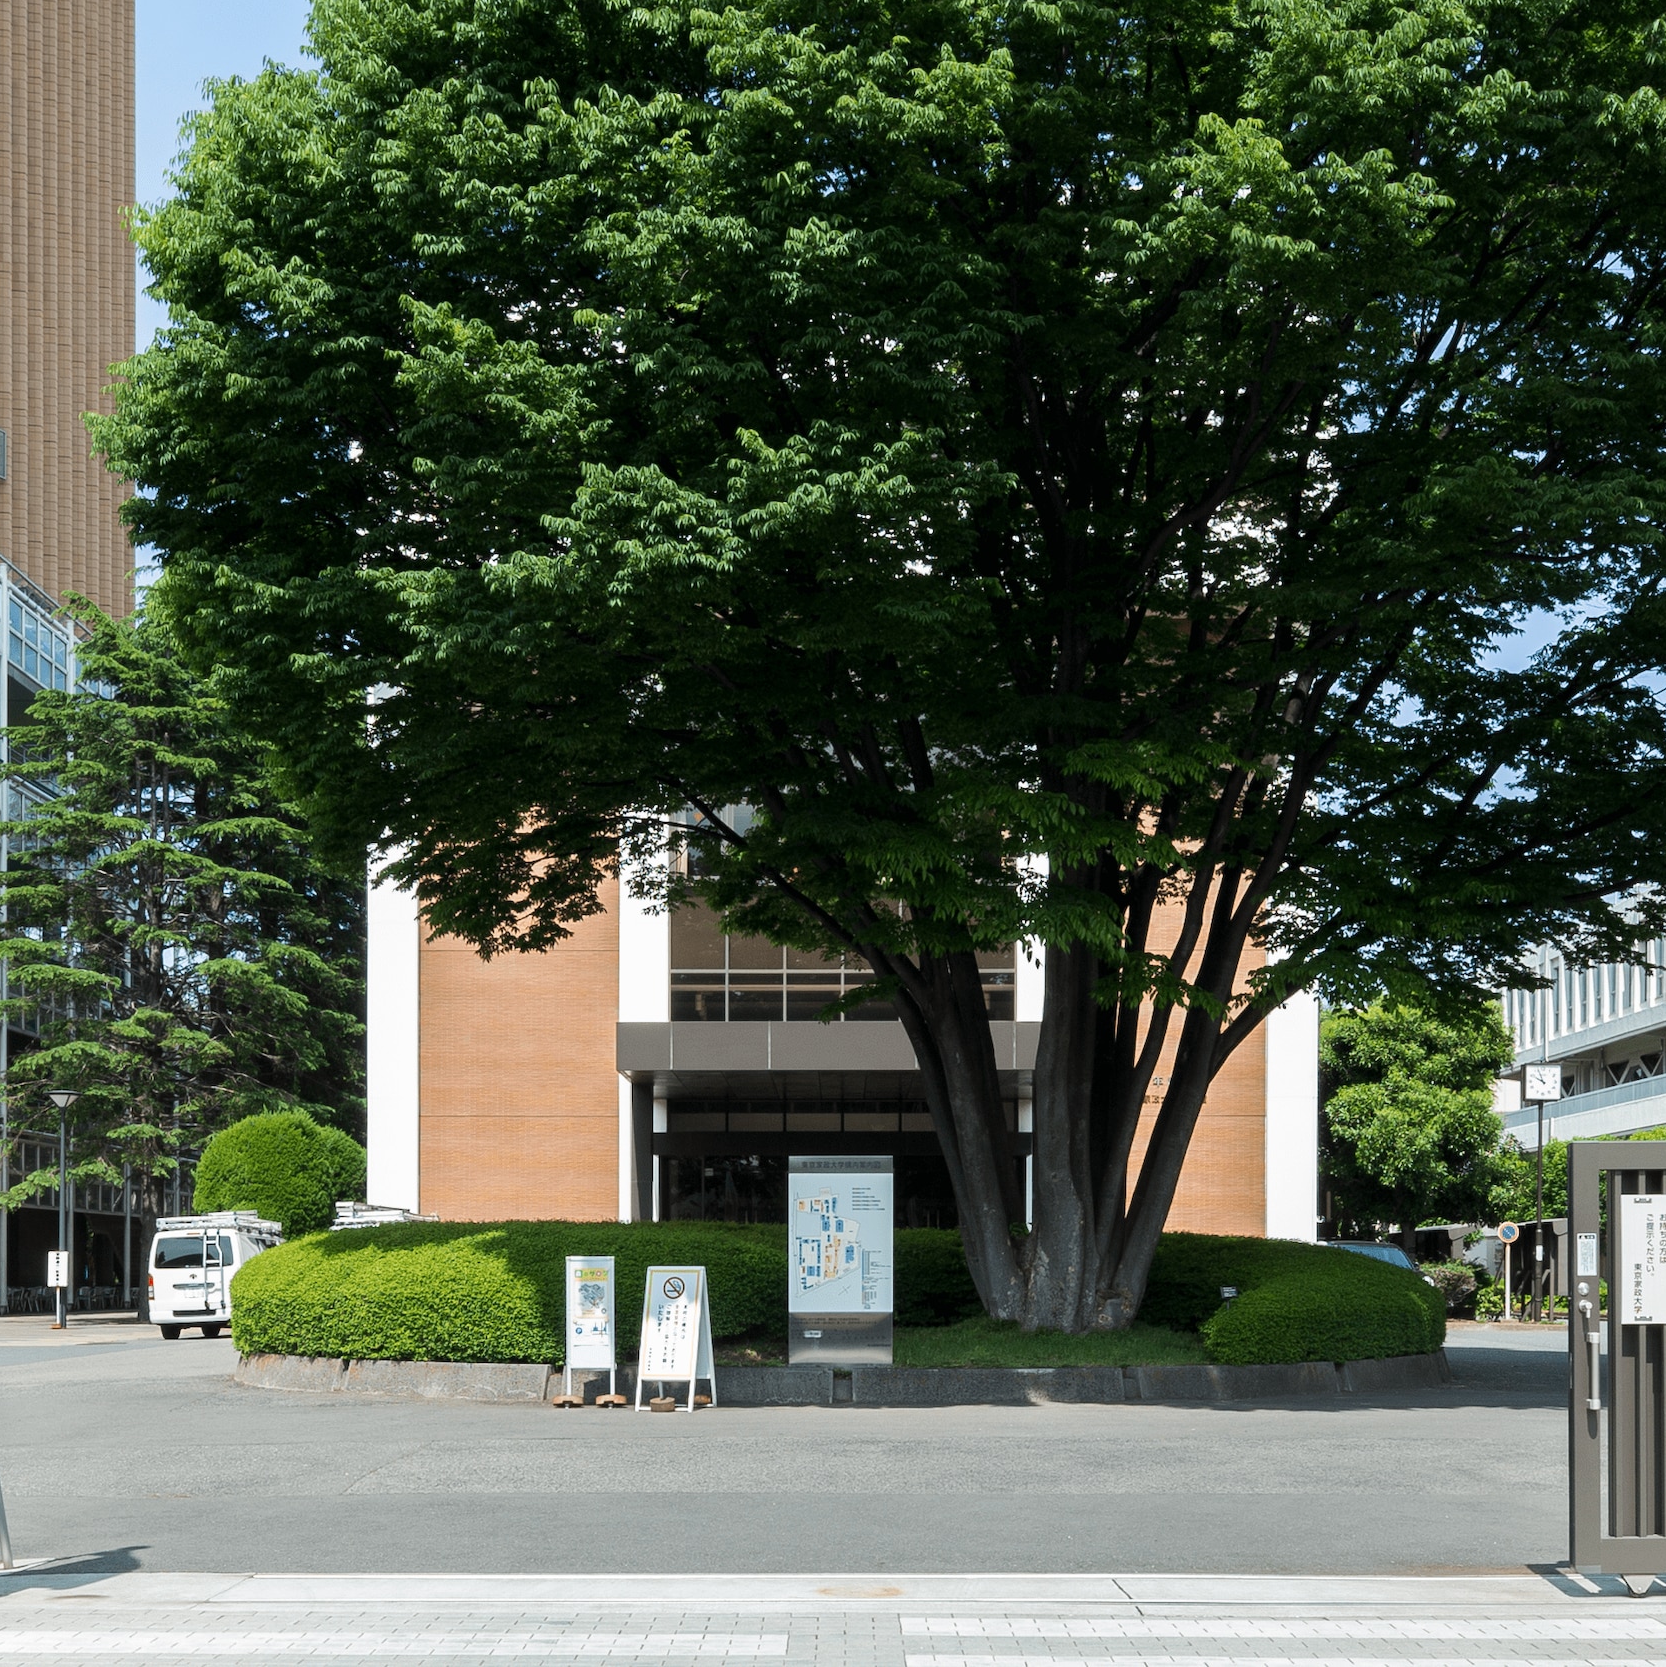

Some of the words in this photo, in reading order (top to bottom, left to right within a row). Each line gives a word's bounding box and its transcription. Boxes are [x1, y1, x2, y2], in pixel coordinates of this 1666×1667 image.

[1646, 1213, 1655, 1277] ご提示ください。
[1634, 1263, 1643, 1314] 東京家政大学
